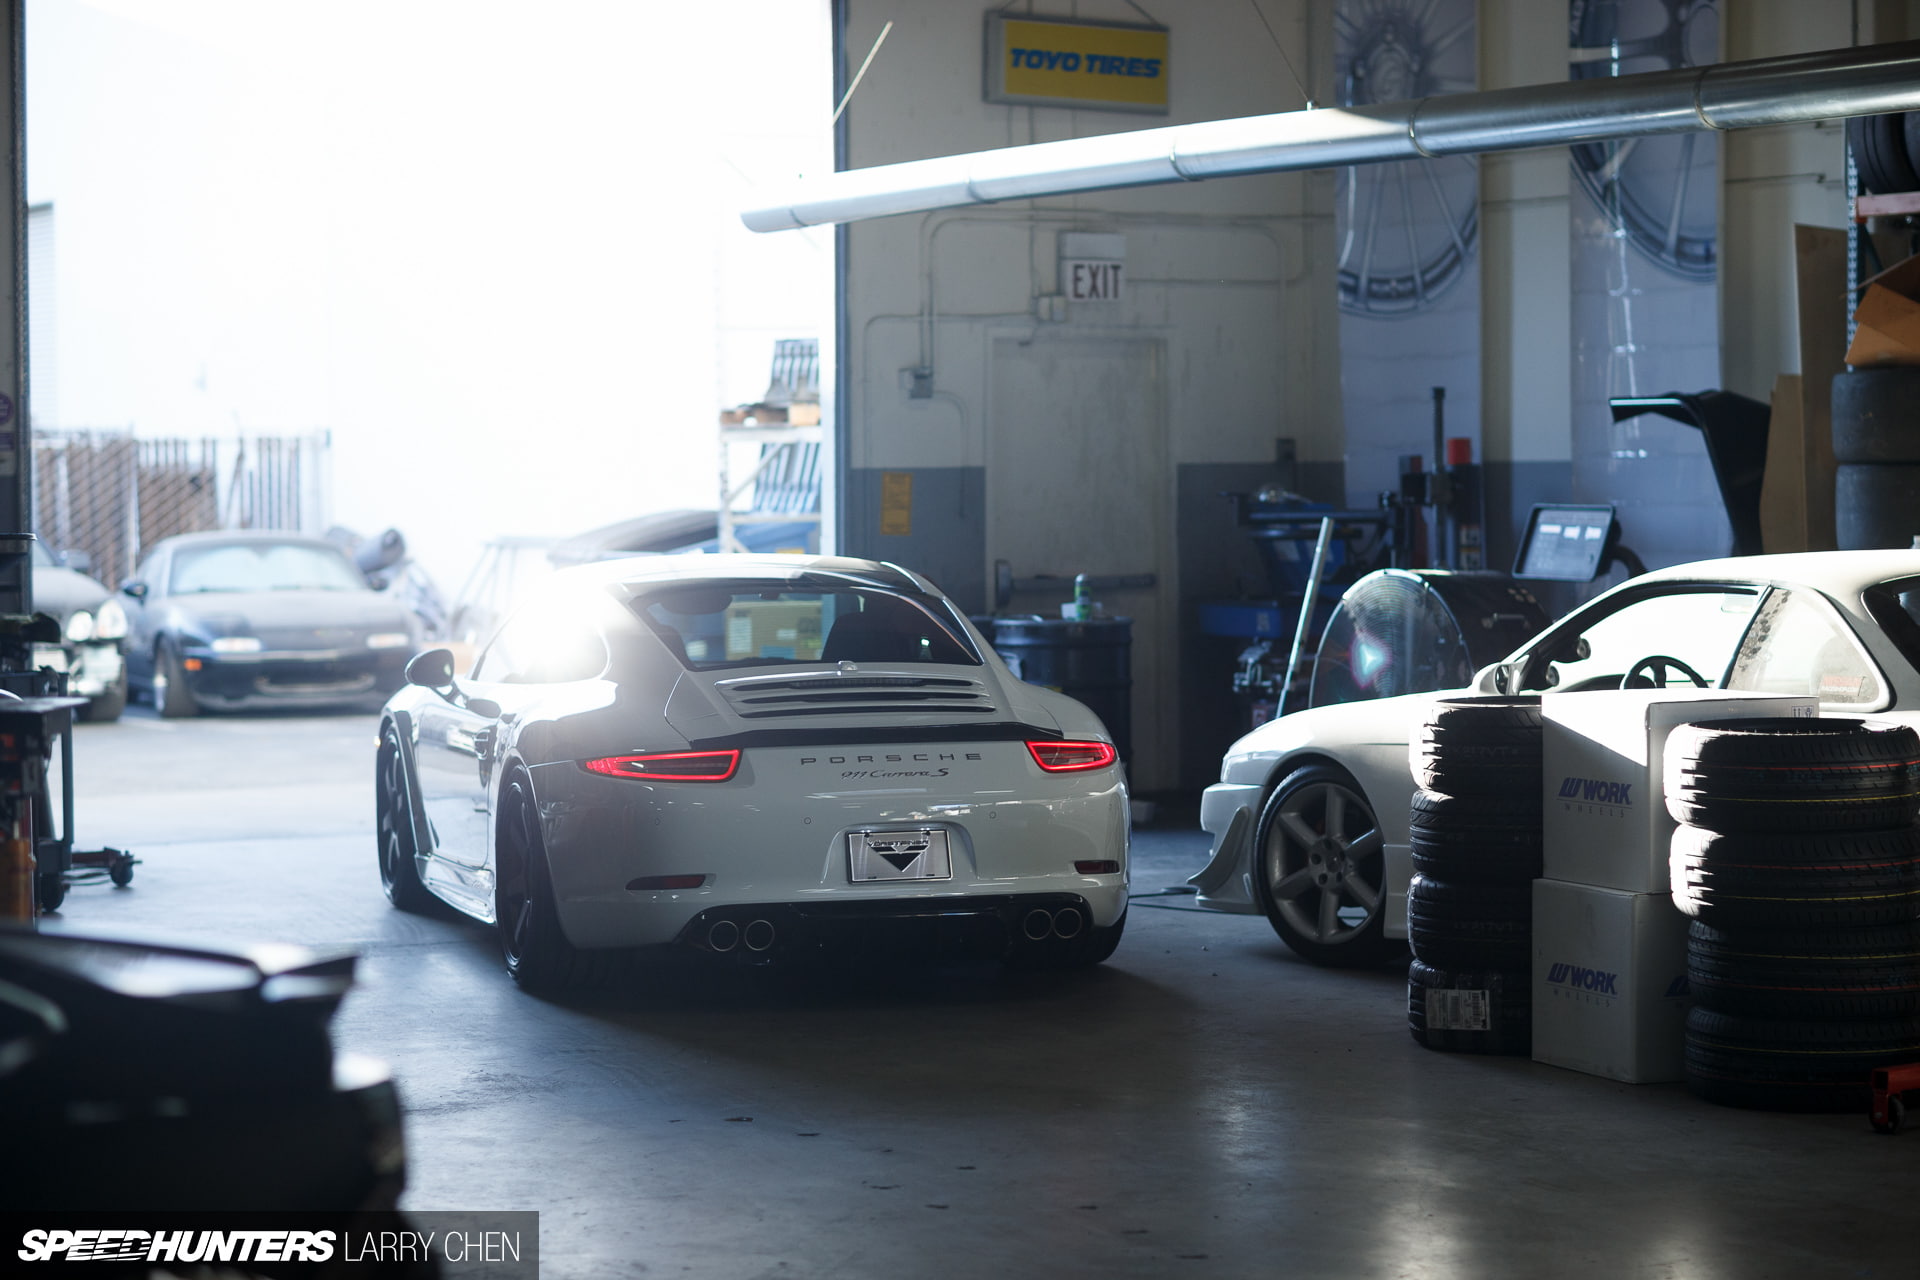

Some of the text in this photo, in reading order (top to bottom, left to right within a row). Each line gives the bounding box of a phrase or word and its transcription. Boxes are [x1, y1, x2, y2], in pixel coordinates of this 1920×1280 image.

[1010, 48, 1162, 79] TOYO TIRES
[1073, 264, 1122, 299] EXIT
[801, 753, 982, 765] PORSCHE
[841, 768, 949, 779] 911 Carrera S
[1583, 779, 1632, 806] WORK
[1570, 965, 1617, 996] WORK
